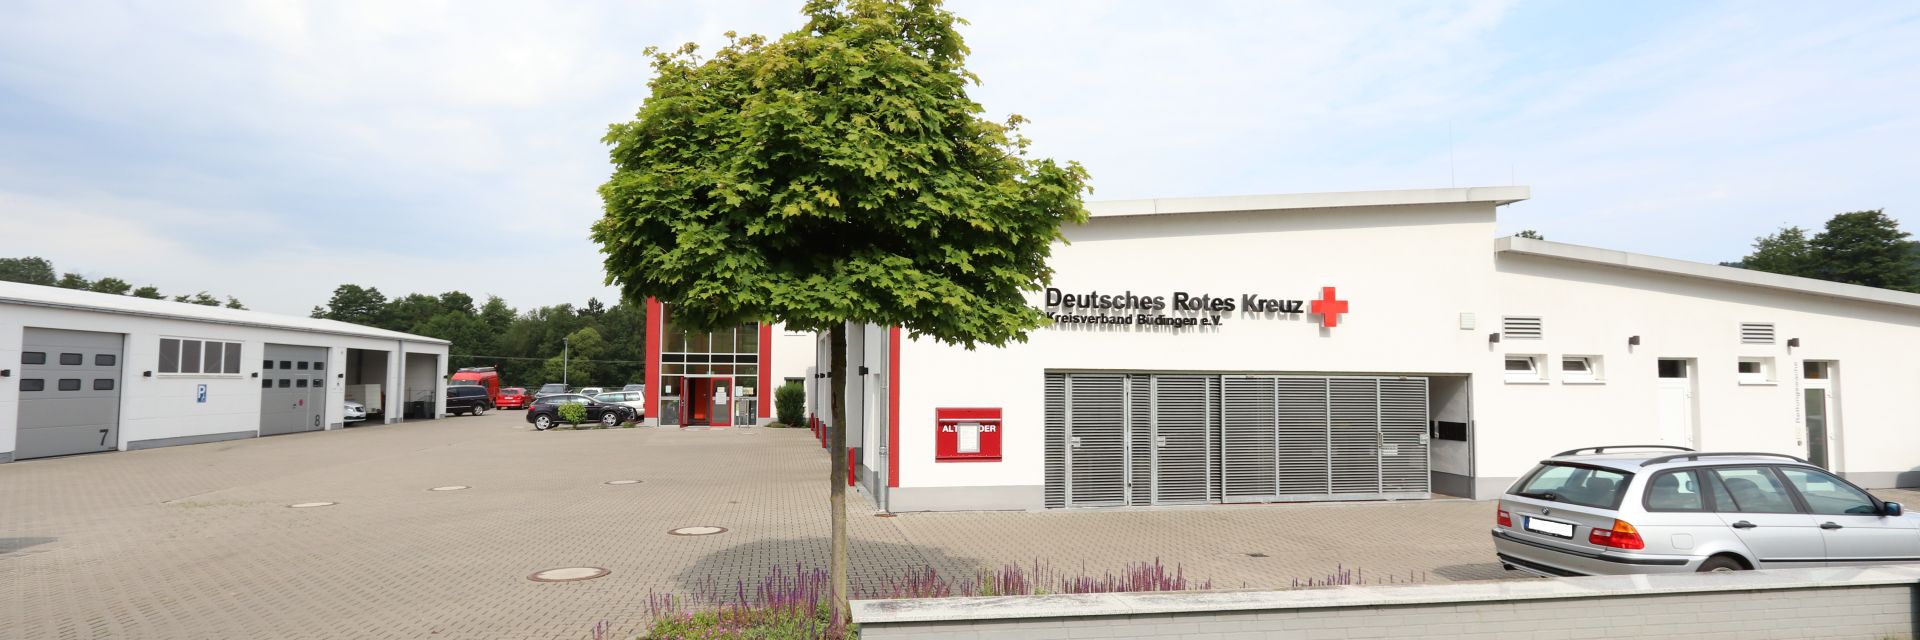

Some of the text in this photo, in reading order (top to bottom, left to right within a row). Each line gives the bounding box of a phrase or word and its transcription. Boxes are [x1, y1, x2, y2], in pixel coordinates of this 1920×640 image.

[1046, 287, 1304, 314] Deutsches Rotes Kreuz
[1046, 311, 1223, 329] Kreisverband Büdingen e.V.
[314, 414, 321, 427] 8
[99, 428, 109, 447] 7
